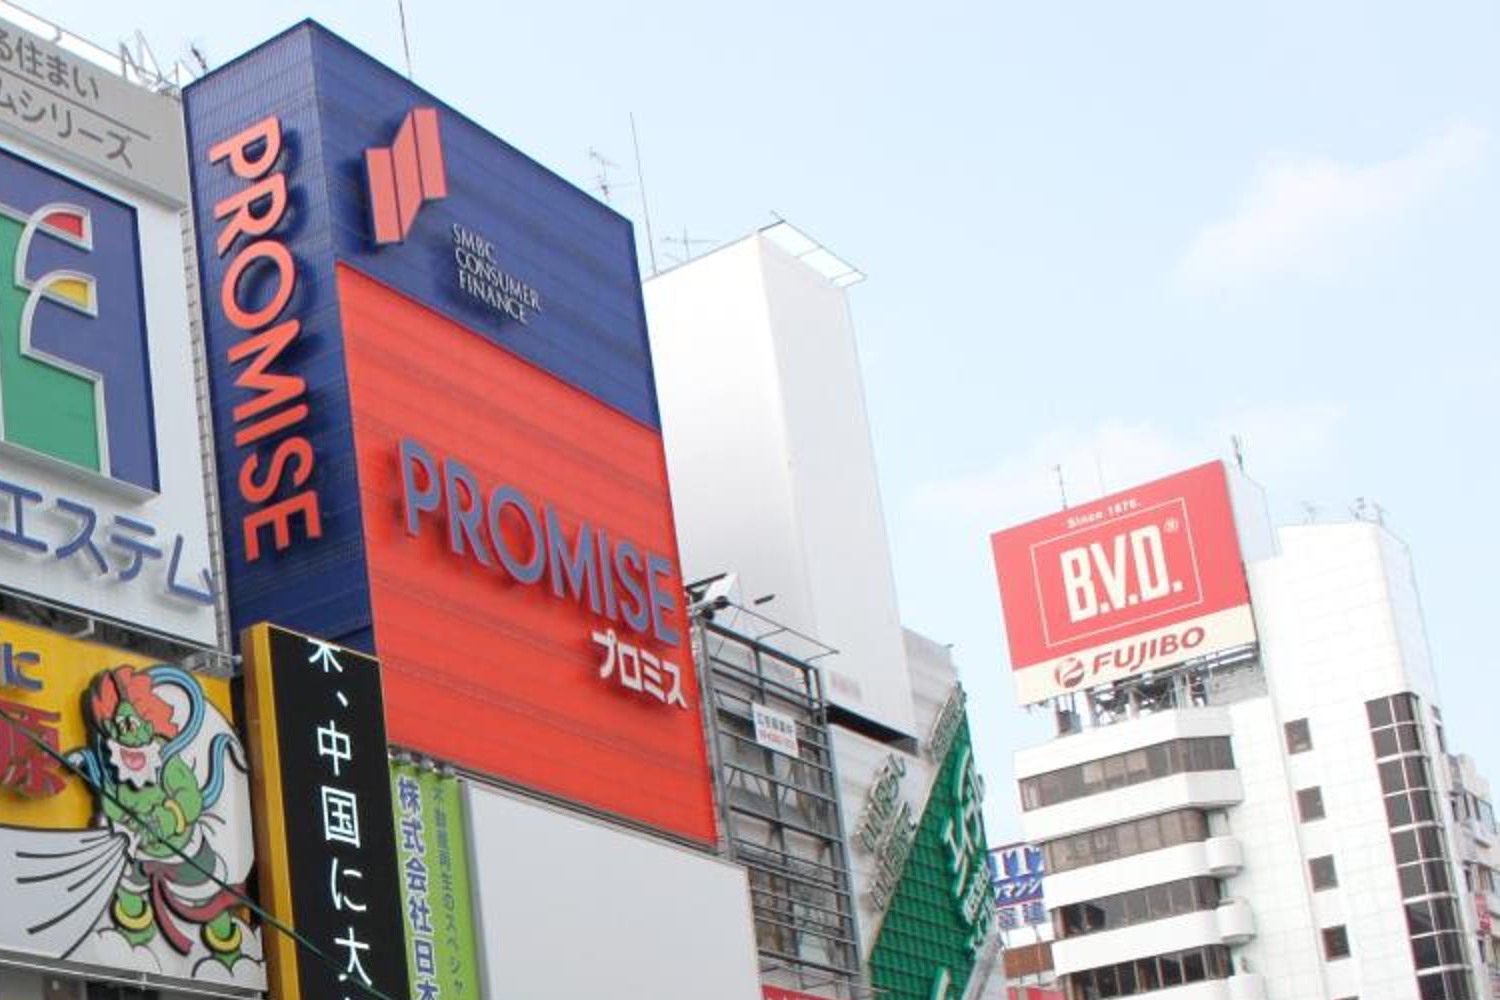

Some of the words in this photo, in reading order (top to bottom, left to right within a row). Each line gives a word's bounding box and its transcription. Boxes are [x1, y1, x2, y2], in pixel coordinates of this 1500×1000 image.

[453, 223, 494, 264] SMBC
[455, 247, 540, 311] CONSUMER
[458, 271, 528, 325] FINANCE
[208, 115, 322, 562] PROMISE
[399, 438, 680, 645] PROMISE
[1060, 524, 1184, 624] B.V.D.
[591, 628, 688, 710] プロミス
[1092, 626, 1206, 675] FUJIBO
